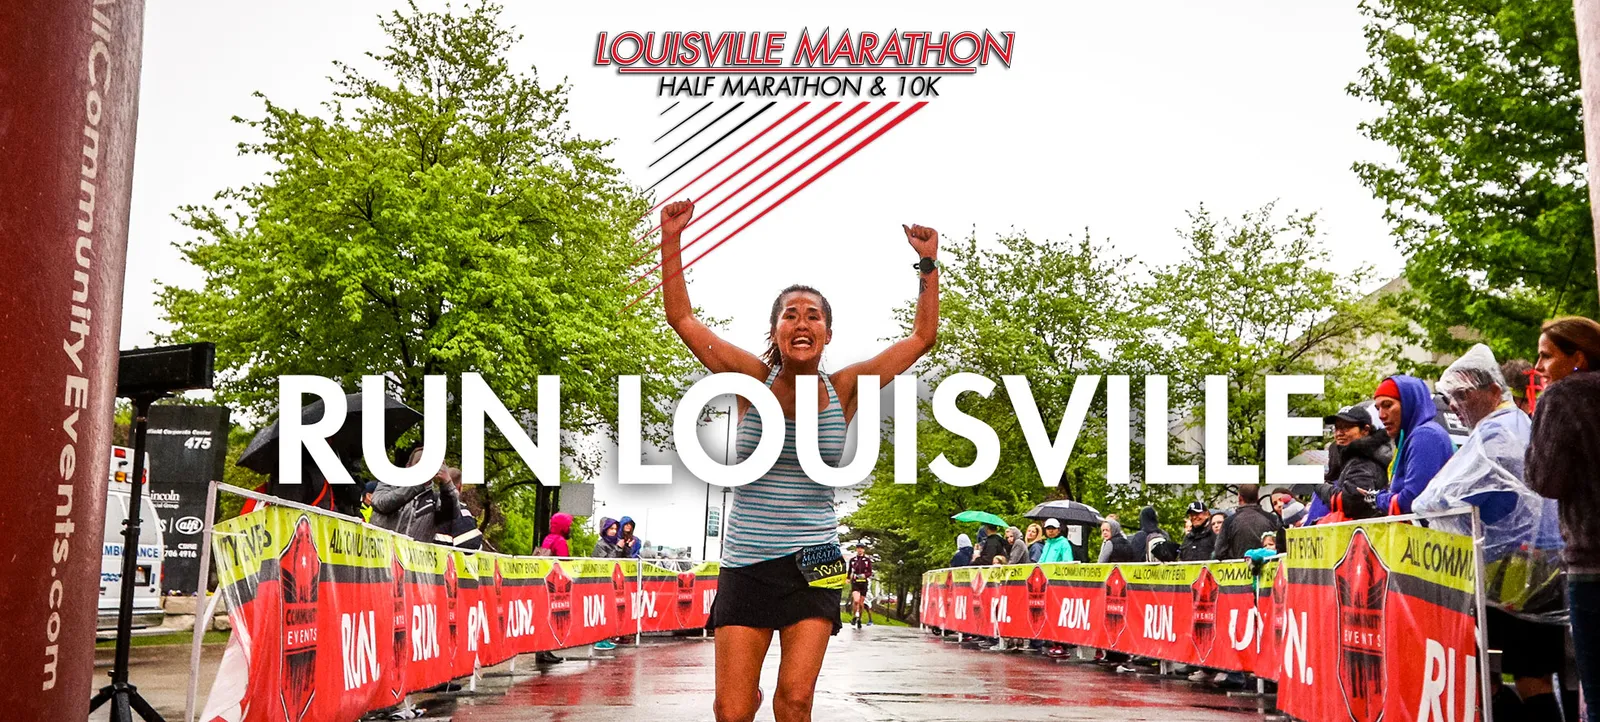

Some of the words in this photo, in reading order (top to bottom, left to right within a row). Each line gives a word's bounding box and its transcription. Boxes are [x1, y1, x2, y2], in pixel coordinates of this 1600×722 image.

[43, 0, 115, 692] llCommunityEvents.com
[184, 436, 212, 450] 475
[150, 489, 180, 501] incoln
[1401, 536, 1421, 568] ALL
[583, 593, 607, 628] RUN.
[1058, 597, 1091, 631] RUN.
[1143, 603, 1177, 643] RUN.
[287, 627, 318, 646] EVENTS
[411, 603, 440, 662] RUN.
[1343, 628, 1382, 648] EVENTS
[340, 609, 381, 691] RUN.
